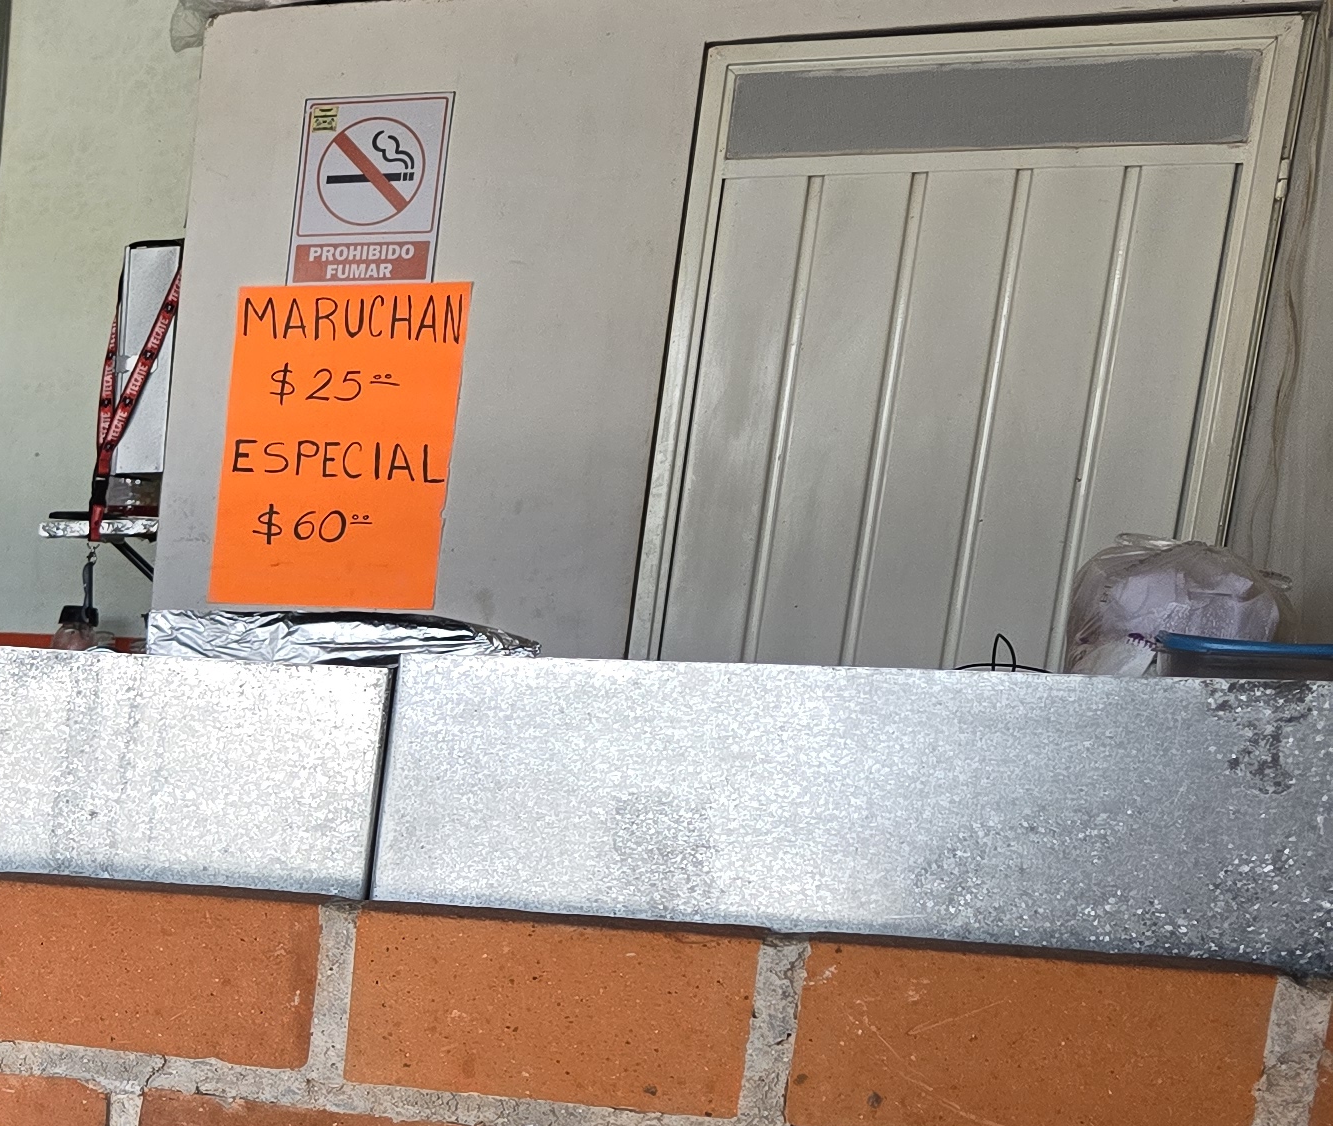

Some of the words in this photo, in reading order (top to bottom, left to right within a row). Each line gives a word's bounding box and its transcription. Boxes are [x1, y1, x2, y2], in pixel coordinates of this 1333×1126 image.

[308, 244, 415, 262] PROHIBIDO
[326, 263, 393, 279] FUMAR
[149, 317, 170, 350] TECATE
[243, 294, 463, 344] MARUCHAN
[129, 364, 150, 397] TECATE
[110, 410, 129, 442] TECATE
[232, 439, 444, 483] ESPECIAL
